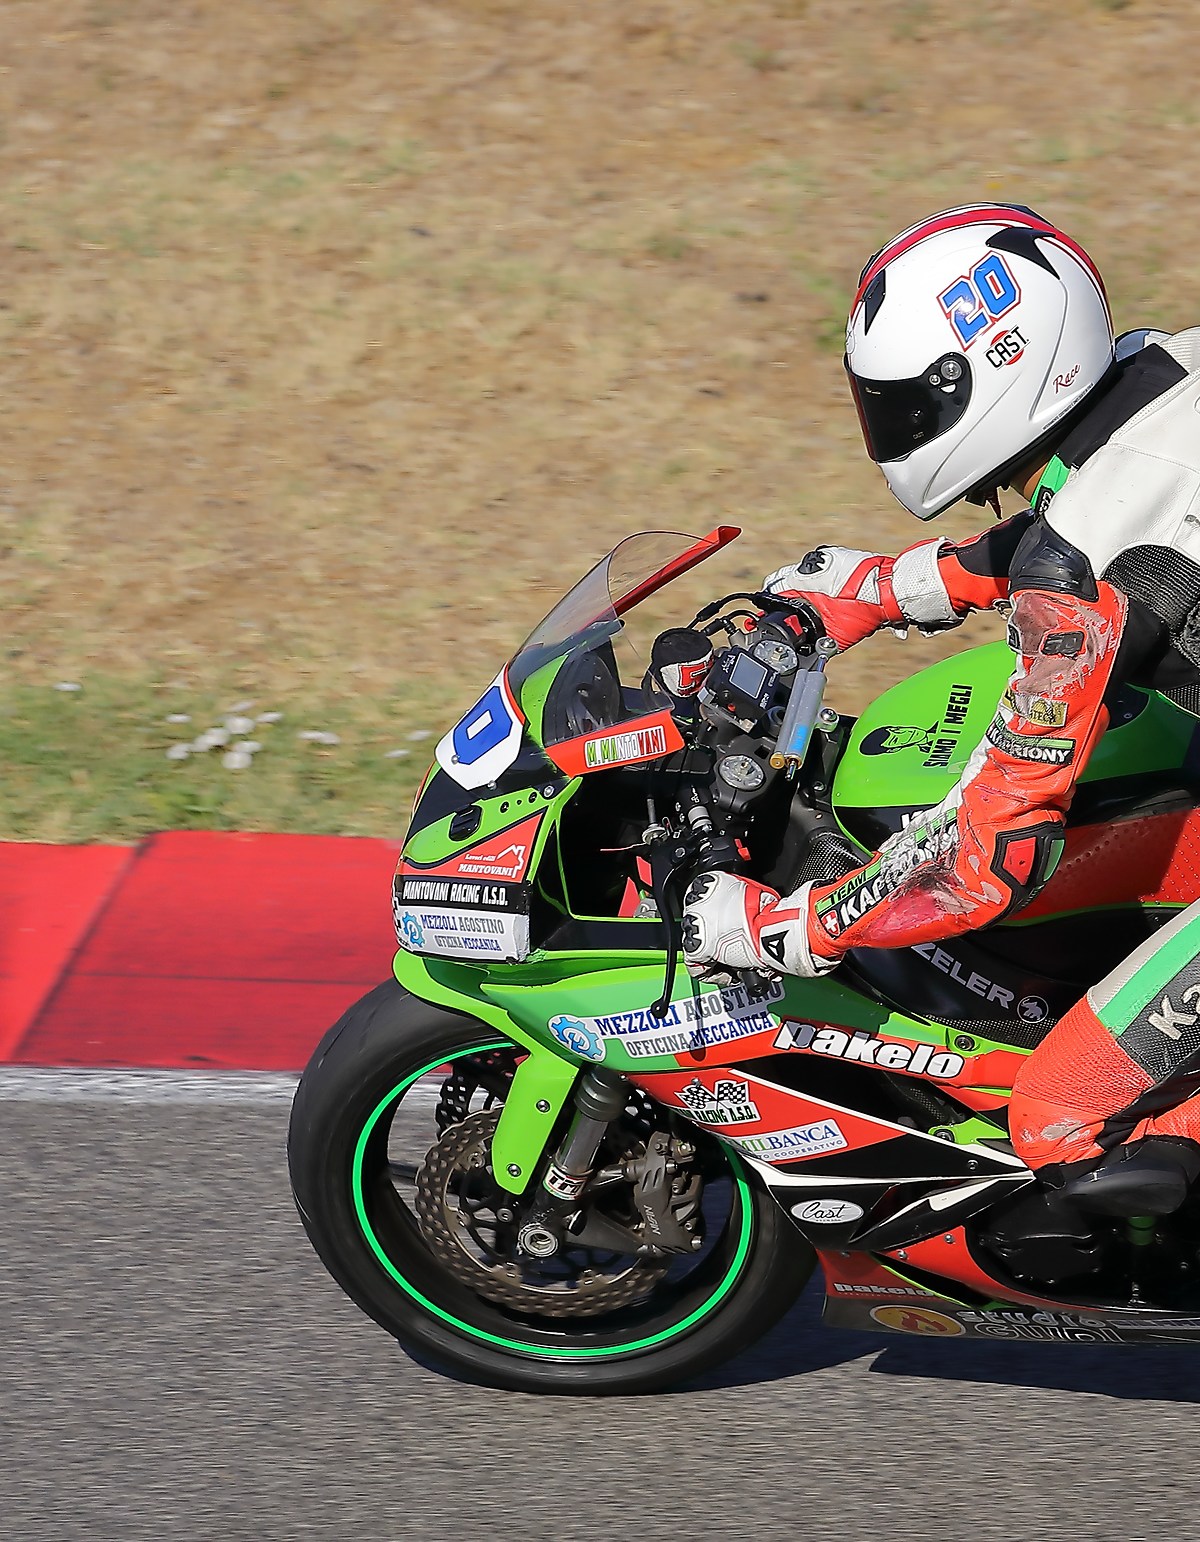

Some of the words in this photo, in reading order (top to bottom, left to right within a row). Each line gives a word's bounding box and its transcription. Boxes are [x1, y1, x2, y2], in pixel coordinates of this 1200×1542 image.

[937, 250, 1021, 352] 20
[1053, 364, 1081, 394] Race
[922, 739, 957, 767] SIAMO
[944, 684, 972, 724] MEGLI
[586, 727, 665, 766] M.MANTOVANI
[457, 863, 513, 877] MANTOVANI
[403, 881, 450, 900] MANTOVANI
[450, 884, 480, 904] RACING
[482, 886, 509, 906] A.S.D.
[827, 870, 867, 905] TEAM
[420, 915, 458, 932] MEZZOLI
[459, 917, 505, 935] AGOSTINO
[911, 942, 1015, 1010] ZELER
[594, 1005, 681, 1036] MEZZOLI
[626, 1033, 690, 1056] OFFICINA
[689, 1011, 773, 1047] MECCANICA
[773, 1020, 965, 1078] pakelo
[694, 1108, 728, 1124] RACING
[730, 1104, 757, 1121] A.S.D.
[774, 1139, 843, 1158] COOPERATIVO
[802, 1201, 851, 1219] Cast
[833, 1282, 936, 1297] pakelo
[956, 1309, 1106, 1328] studio
